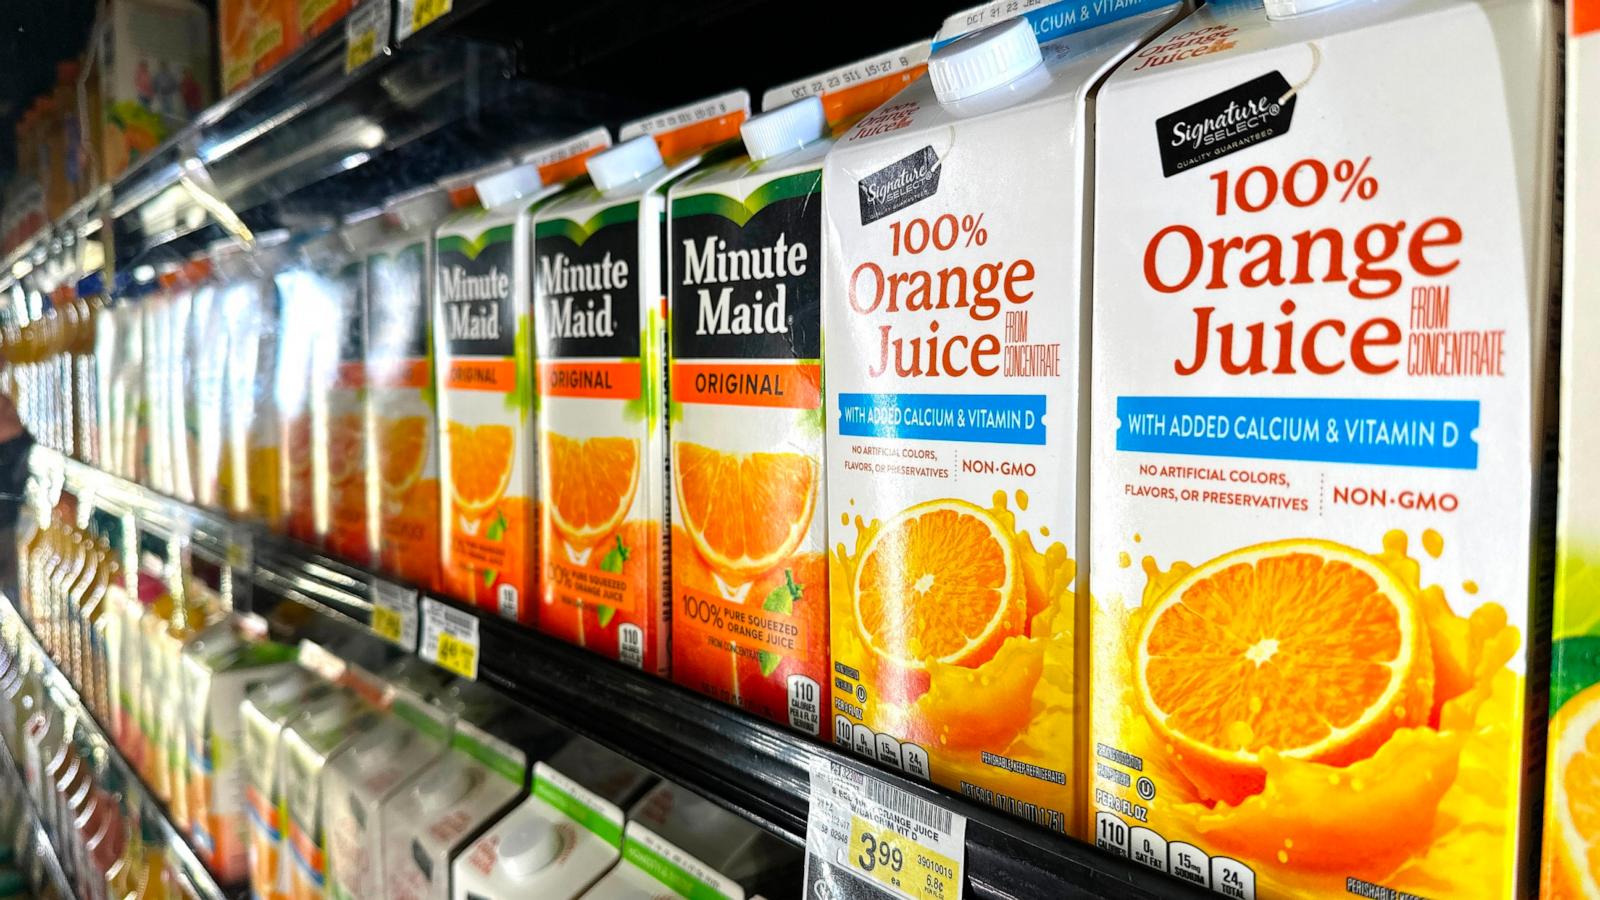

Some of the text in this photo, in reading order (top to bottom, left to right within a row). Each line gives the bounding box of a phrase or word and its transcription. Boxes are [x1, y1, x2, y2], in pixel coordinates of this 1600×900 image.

[967, 14, 984, 26] OCT
[1034, 8, 1076, 35] LCIUM
[1080, 6, 1090, 21] &
[1138, 28, 1239, 57] Orange
[1134, 45, 1209, 71] Juice
[791, 87, 807, 99] OCT
[849, 122, 897, 141] Juice
[1171, 97, 1272, 149] Signature
[1177, 129, 1273, 169] QUALITY GUARANTEED
[867, 165, 928, 205] Signature
[1210, 157, 1379, 216] 100%
[889, 213, 988, 256] 100%
[683, 232, 808, 286] Minute
[1143, 217, 1463, 300] Orange
[439, 264, 509, 303] Minute
[540, 251, 629, 296] Minute
[849, 259, 1035, 321] Orange
[451, 302, 499, 340] Maid
[550, 294, 613, 339] Maid
[696, 283, 788, 335] Maid
[1411, 287, 1450, 330] FROM
[1004, 310, 1028, 343] FROM
[1174, 300, 1402, 376] Juice
[868, 320, 1001, 378] Juice
[1003, 344, 1061, 378] CONCENTRATE
[1407, 331, 1505, 378] CONCENTRATE
[551, 370, 613, 390] ORIGINAL
[696, 373, 784, 396] ORIGINAL
[844, 406, 1035, 430] WITH ADDED CALCIUM & VITAMIN D
[1128, 413, 1459, 448] WITH ADDED CALCIUM & VITAMIN D
[852, 445, 862, 454] NO
[902, 449, 938, 461] COLORS,
[844, 461, 949, 479] FLAVORS, OR PRESERVATIVES
[1139, 464, 1290, 488] NO ARTIFICIAL COLORS,
[1125, 484, 1309, 512] FLAVORS, OR PRESERVATIVES
[683, 594, 799, 636] 100% PURE SQUEEZED
[623, 628, 638, 646] 110
[728, 622, 794, 650] ORANGE JUICE
[791, 698, 816, 713] CALORIES
[794, 681, 813, 702] 110
[838, 719, 850, 740] 110
[1096, 788, 1148, 823] PER 8 FL OZ
[897, 825, 910, 839] VIT
[912, 830, 918, 841] D
[914, 823, 939, 842] JUICE
[1100, 818, 1124, 847] 110
[917, 855, 953, 880] 39010019
[1135, 851, 1162, 869] SAT FAT
[891, 876, 900, 887] ea
[1175, 866, 1205, 886] SODIUM
[1223, 868, 1244, 889] 24g
[1221, 883, 1246, 900] TOTAL
